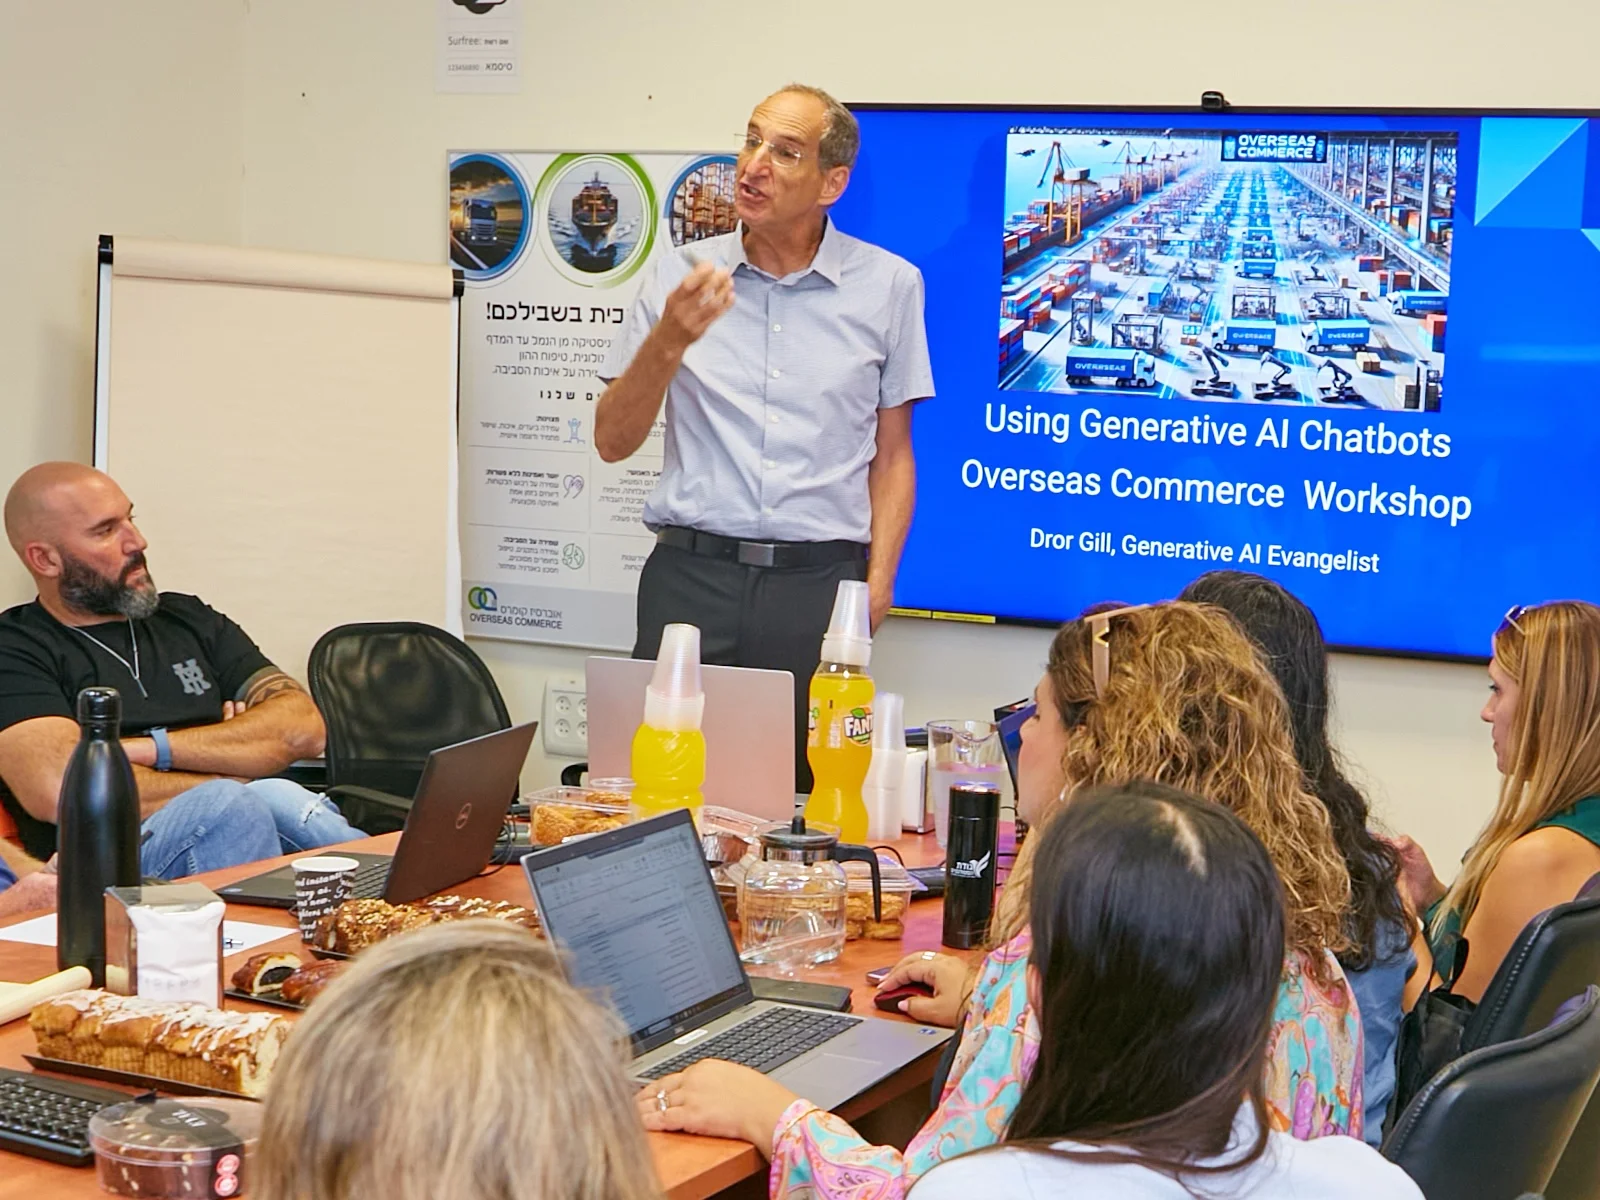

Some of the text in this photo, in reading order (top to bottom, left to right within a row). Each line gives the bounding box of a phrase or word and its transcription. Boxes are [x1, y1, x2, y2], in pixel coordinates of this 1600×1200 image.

[1238, 134, 1316, 147] OVERSEAS
[1237, 147, 1314, 158] COMMERCE
[486, 301, 582, 323] בשבילכם!
[486, 334, 513, 346] המדף
[516, 335, 529, 345] עד
[532, 335, 556, 347] הנמל
[559, 337, 569, 349] מן
[519, 351, 538, 362] ההון
[541, 351, 568, 361] טיפוח
[533, 366, 560, 376] איכות
[563, 367, 576, 377] על
[984, 402, 1452, 458] Using Generative AI Chatbots
[961, 458, 1472, 527] Overseas Commerce Workshop
[1029, 527, 1380, 574] Dror Gill, Generative AI Evangelist
[500, 605, 562, 619] אוברסיז קומרס
[469, 613, 563, 629] OVERSEAS COMMERCE
